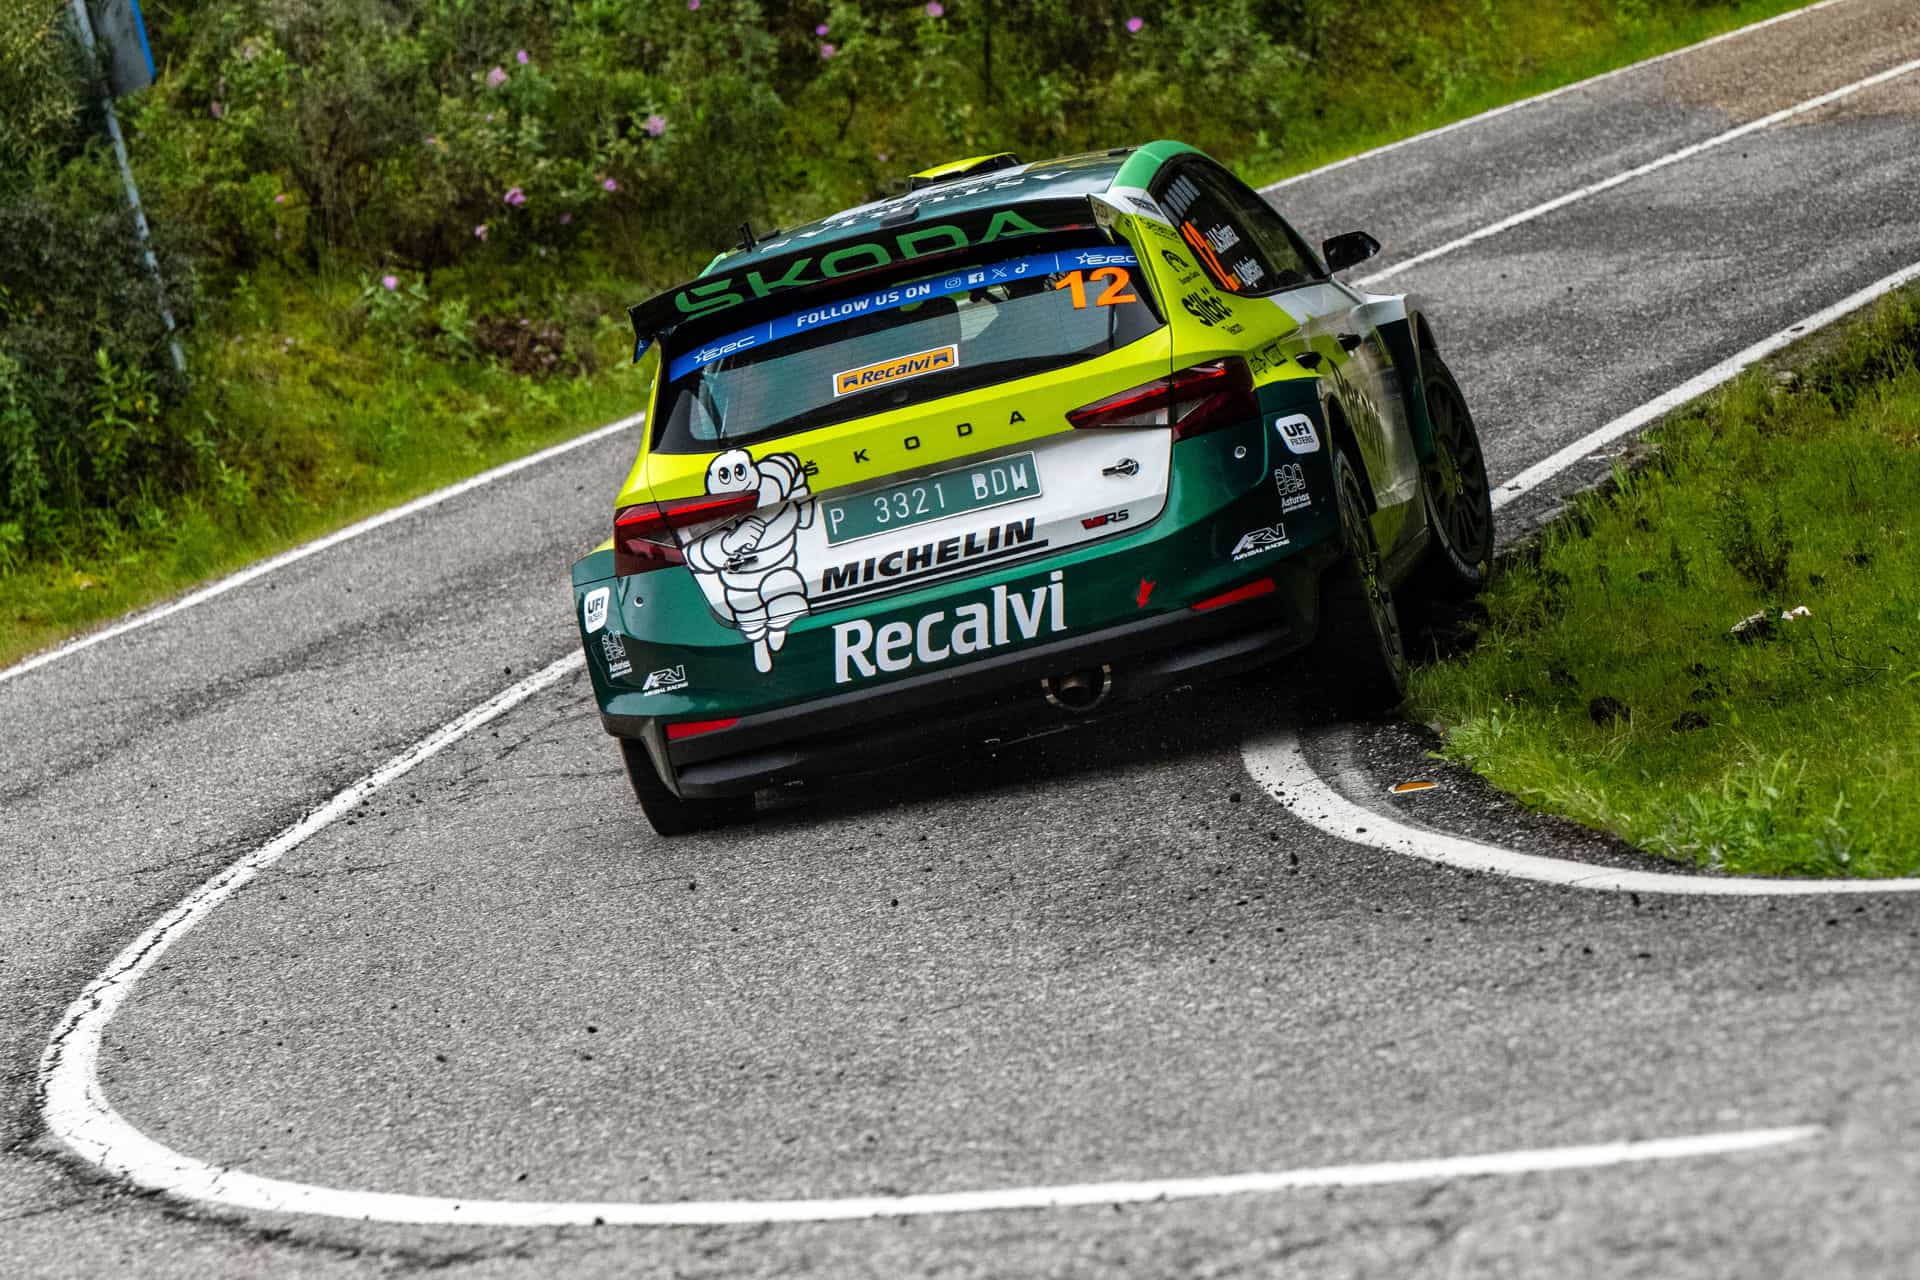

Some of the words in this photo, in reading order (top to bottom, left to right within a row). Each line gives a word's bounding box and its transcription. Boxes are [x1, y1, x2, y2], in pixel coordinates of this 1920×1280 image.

[797, 299, 870, 328] FOLLOW
[875, 289, 899, 306] US
[905, 283, 931, 298] ON
[1055, 266, 1137, 310] 12
[861, 356, 931, 384] Recalvi
[1283, 421, 1311, 437] UFI
[829, 507, 846, 536] P
[873, 483, 945, 524] 3321
[822, 517, 1036, 593] MICHELIN
[587, 596, 605, 614] UFI
[832, 570, 1068, 684] Recalvi
